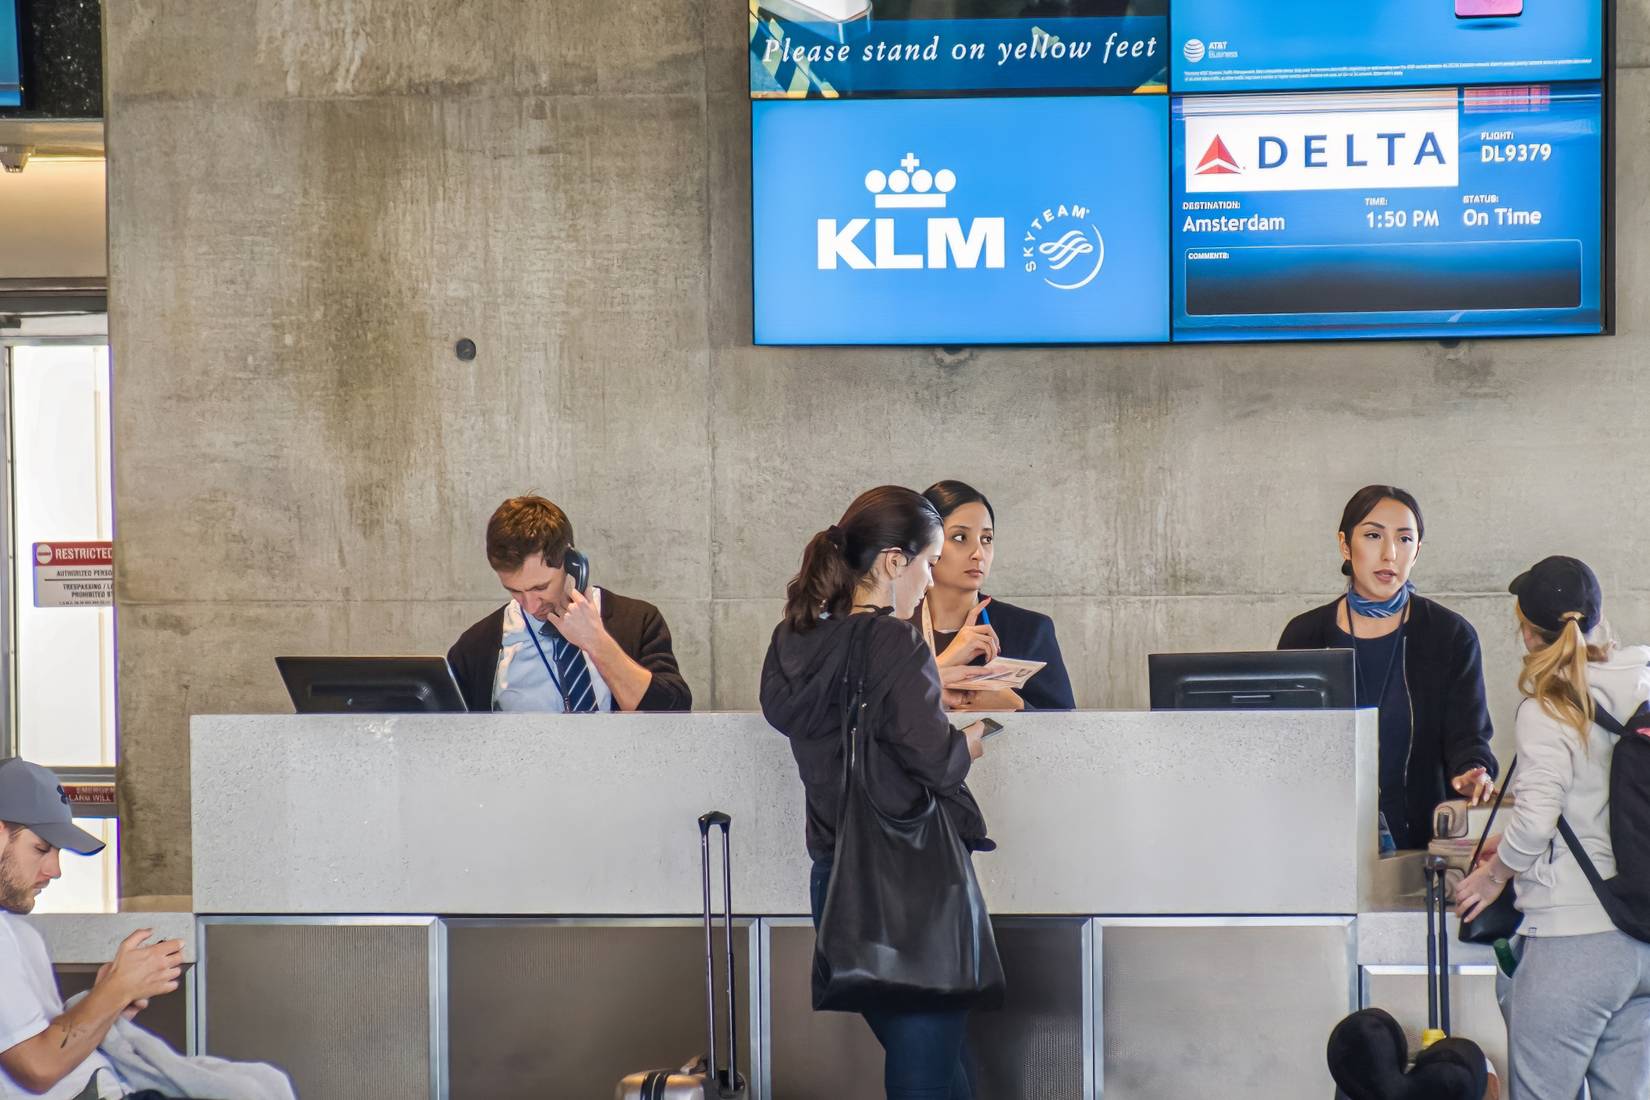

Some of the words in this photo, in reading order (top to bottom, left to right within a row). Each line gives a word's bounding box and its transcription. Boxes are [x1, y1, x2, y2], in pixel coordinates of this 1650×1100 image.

[762, 37, 850, 62] Please
[862, 35, 940, 62] stand
[951, 42, 985, 60] on
[997, 33, 1092, 66] yellow
[1102, 32, 1157, 64] feet
[1480, 131, 1514, 140] FLIGHT:
[1258, 131, 1446, 169] DELTA
[1481, 143, 1552, 163] DL9379
[1182, 201, 1241, 210] DESTINATION:
[1365, 197, 1388, 206] TIME:
[1182, 213, 1286, 233] Amsterdam
[1366, 210, 1407, 228] 1:50
[1412, 209, 1440, 228] PM
[1463, 208, 1489, 226] On
[1494, 207, 1542, 226] Time
[817, 216, 1005, 269] KLM
[1023, 204, 1087, 272] SKYTEAM
